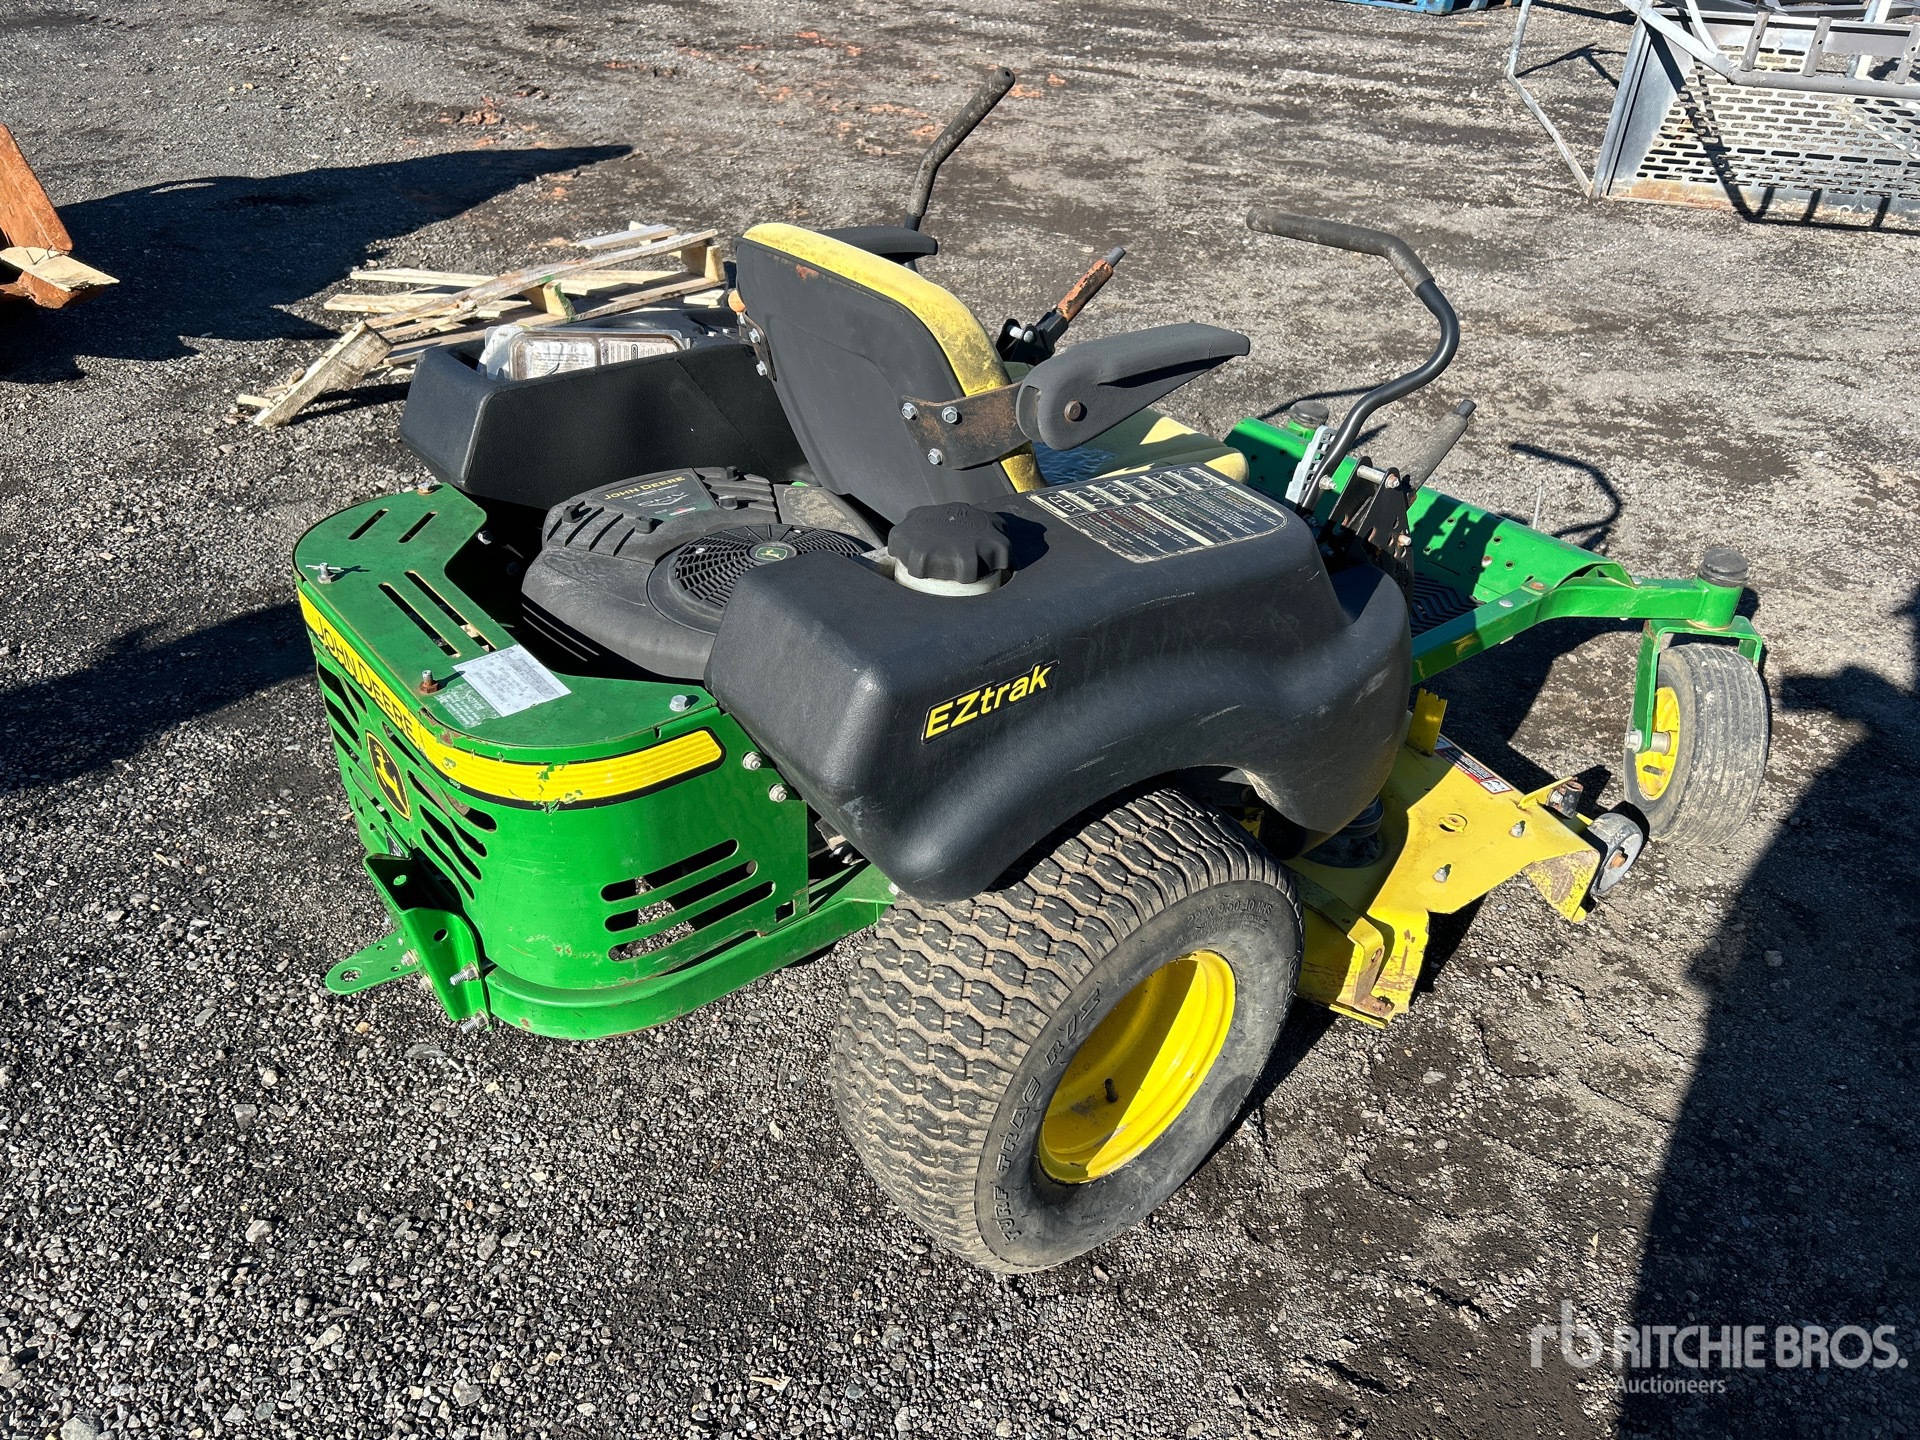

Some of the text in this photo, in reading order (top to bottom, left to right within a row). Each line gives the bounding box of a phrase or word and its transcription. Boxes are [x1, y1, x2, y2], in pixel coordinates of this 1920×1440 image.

[604, 487, 640, 500] JOHN
[640, 475, 686, 491] DEERE
[318, 617, 417, 743] JOHN DEERE
[925, 664, 1053, 739] EZtrak
[996, 1076, 1042, 1172] TRAC
[993, 1184, 1022, 1244] TURF
